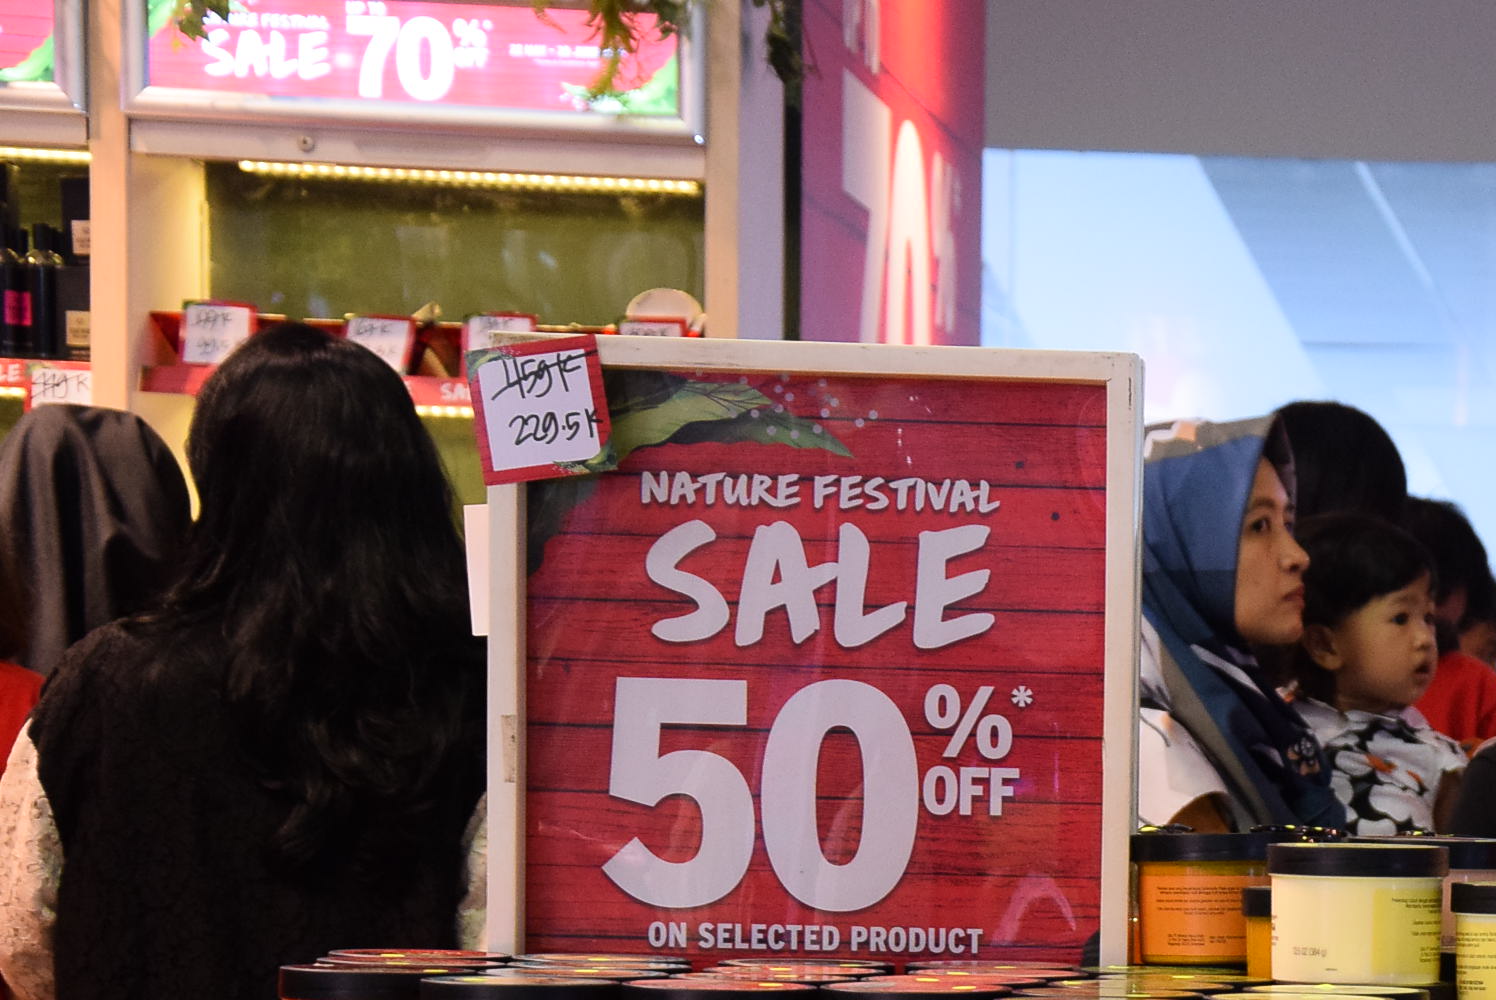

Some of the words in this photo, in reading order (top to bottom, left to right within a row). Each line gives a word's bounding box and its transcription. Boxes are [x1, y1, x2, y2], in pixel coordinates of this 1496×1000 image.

[201, 28, 332, 80] SALE
[346, 14, 454, 100] 70
[508, 407, 604, 446] 229.5K
[640, 471, 802, 509] NATURE
[813, 474, 1000, 514] FESTIVAL
[645, 520, 996, 650] SALE
[601, 676, 920, 912] 50
[923, 766, 1021, 817] OFF
[648, 922, 687, 949] ON
[698, 922, 841, 952] SELECTED
[850, 924, 984, 955] PRODUCT
